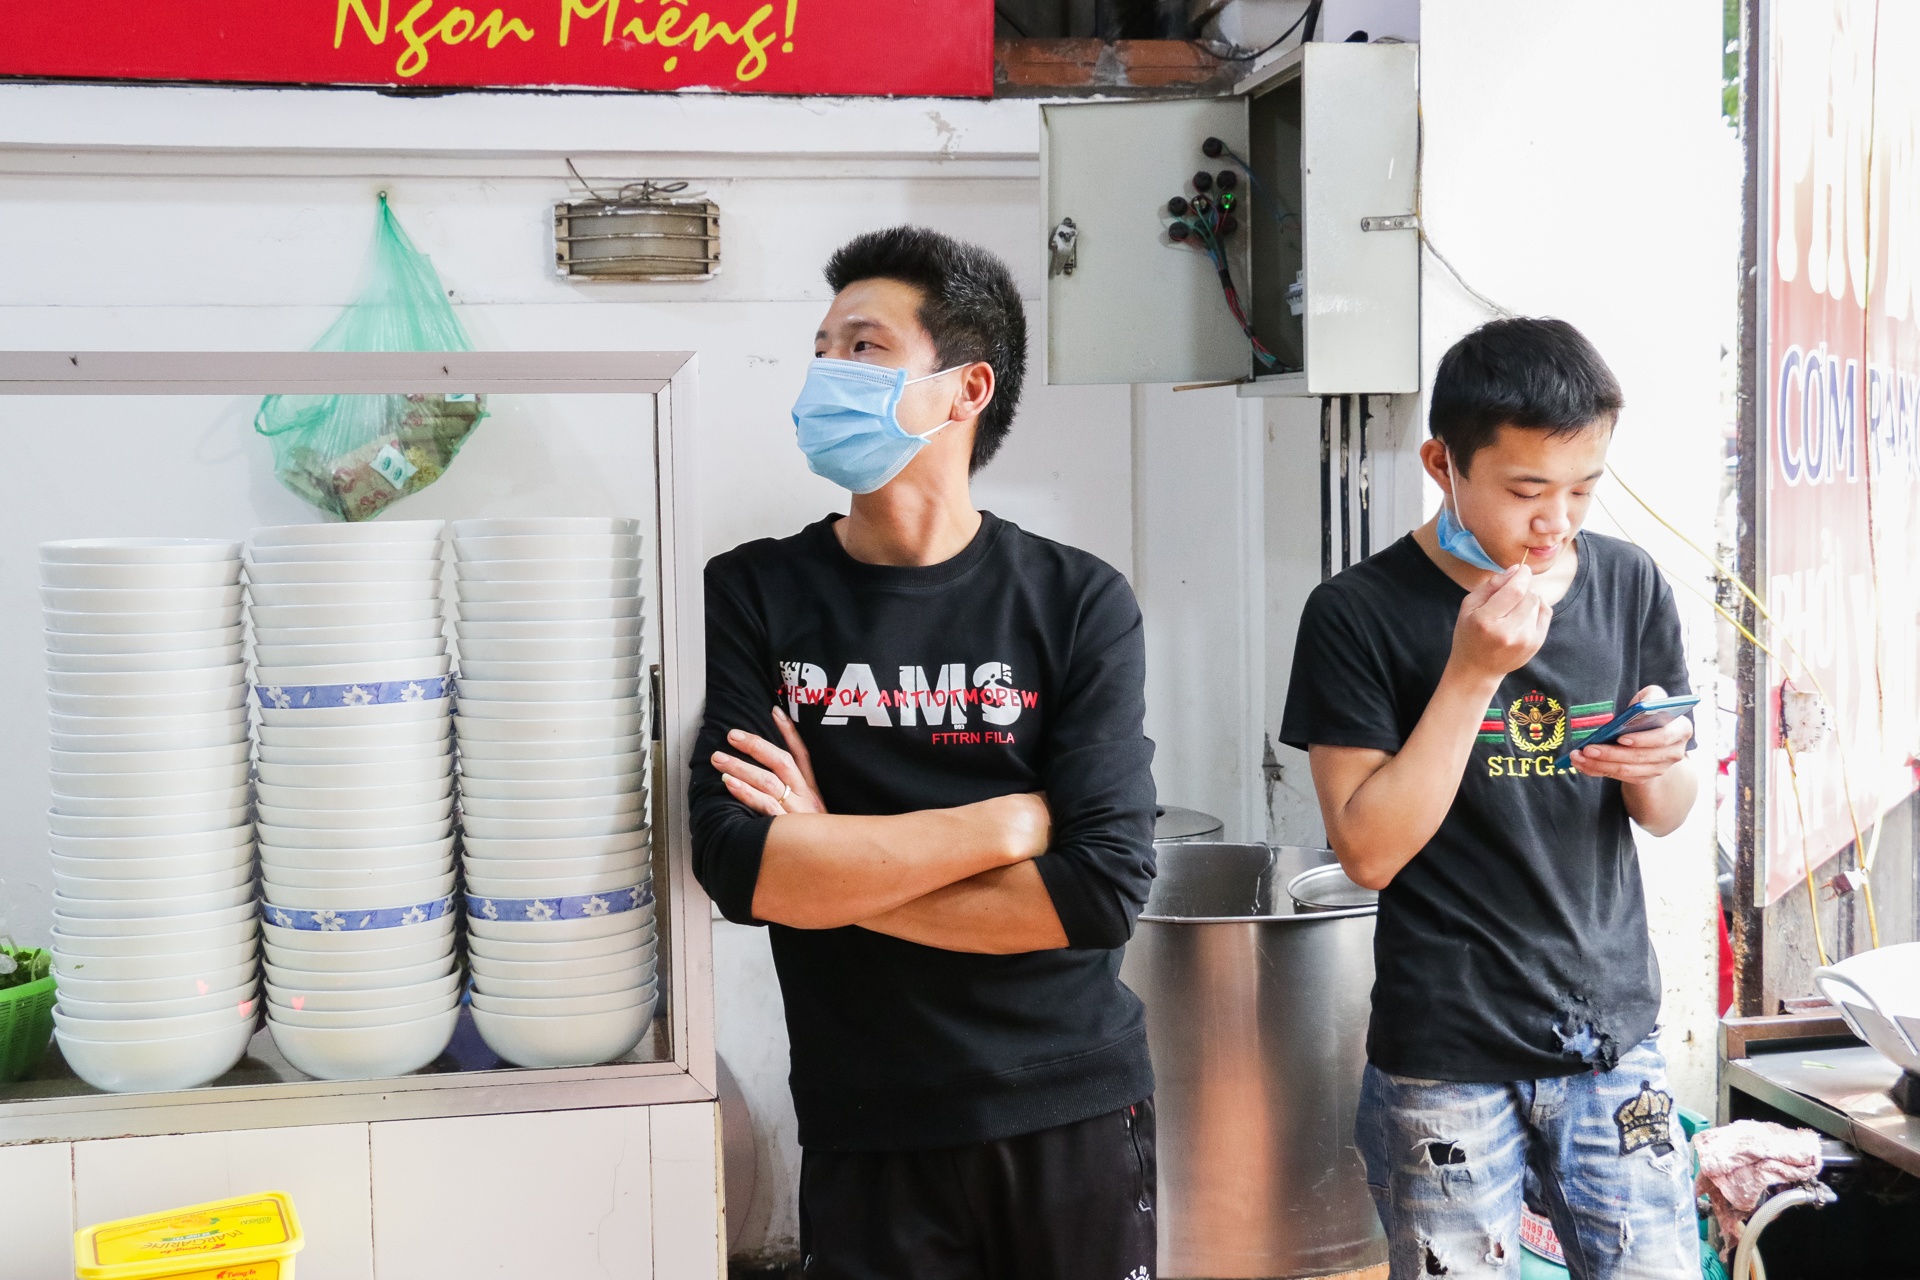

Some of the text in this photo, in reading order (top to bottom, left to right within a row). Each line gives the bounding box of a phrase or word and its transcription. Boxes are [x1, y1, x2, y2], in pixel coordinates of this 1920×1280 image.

[333, 0, 796, 81] Ngon Miệng!
[932, 732, 1015, 745] FTTRN FILA
[1487, 755, 1577, 777] SIFG
[141, 1229, 243, 1250] MARGARINE
